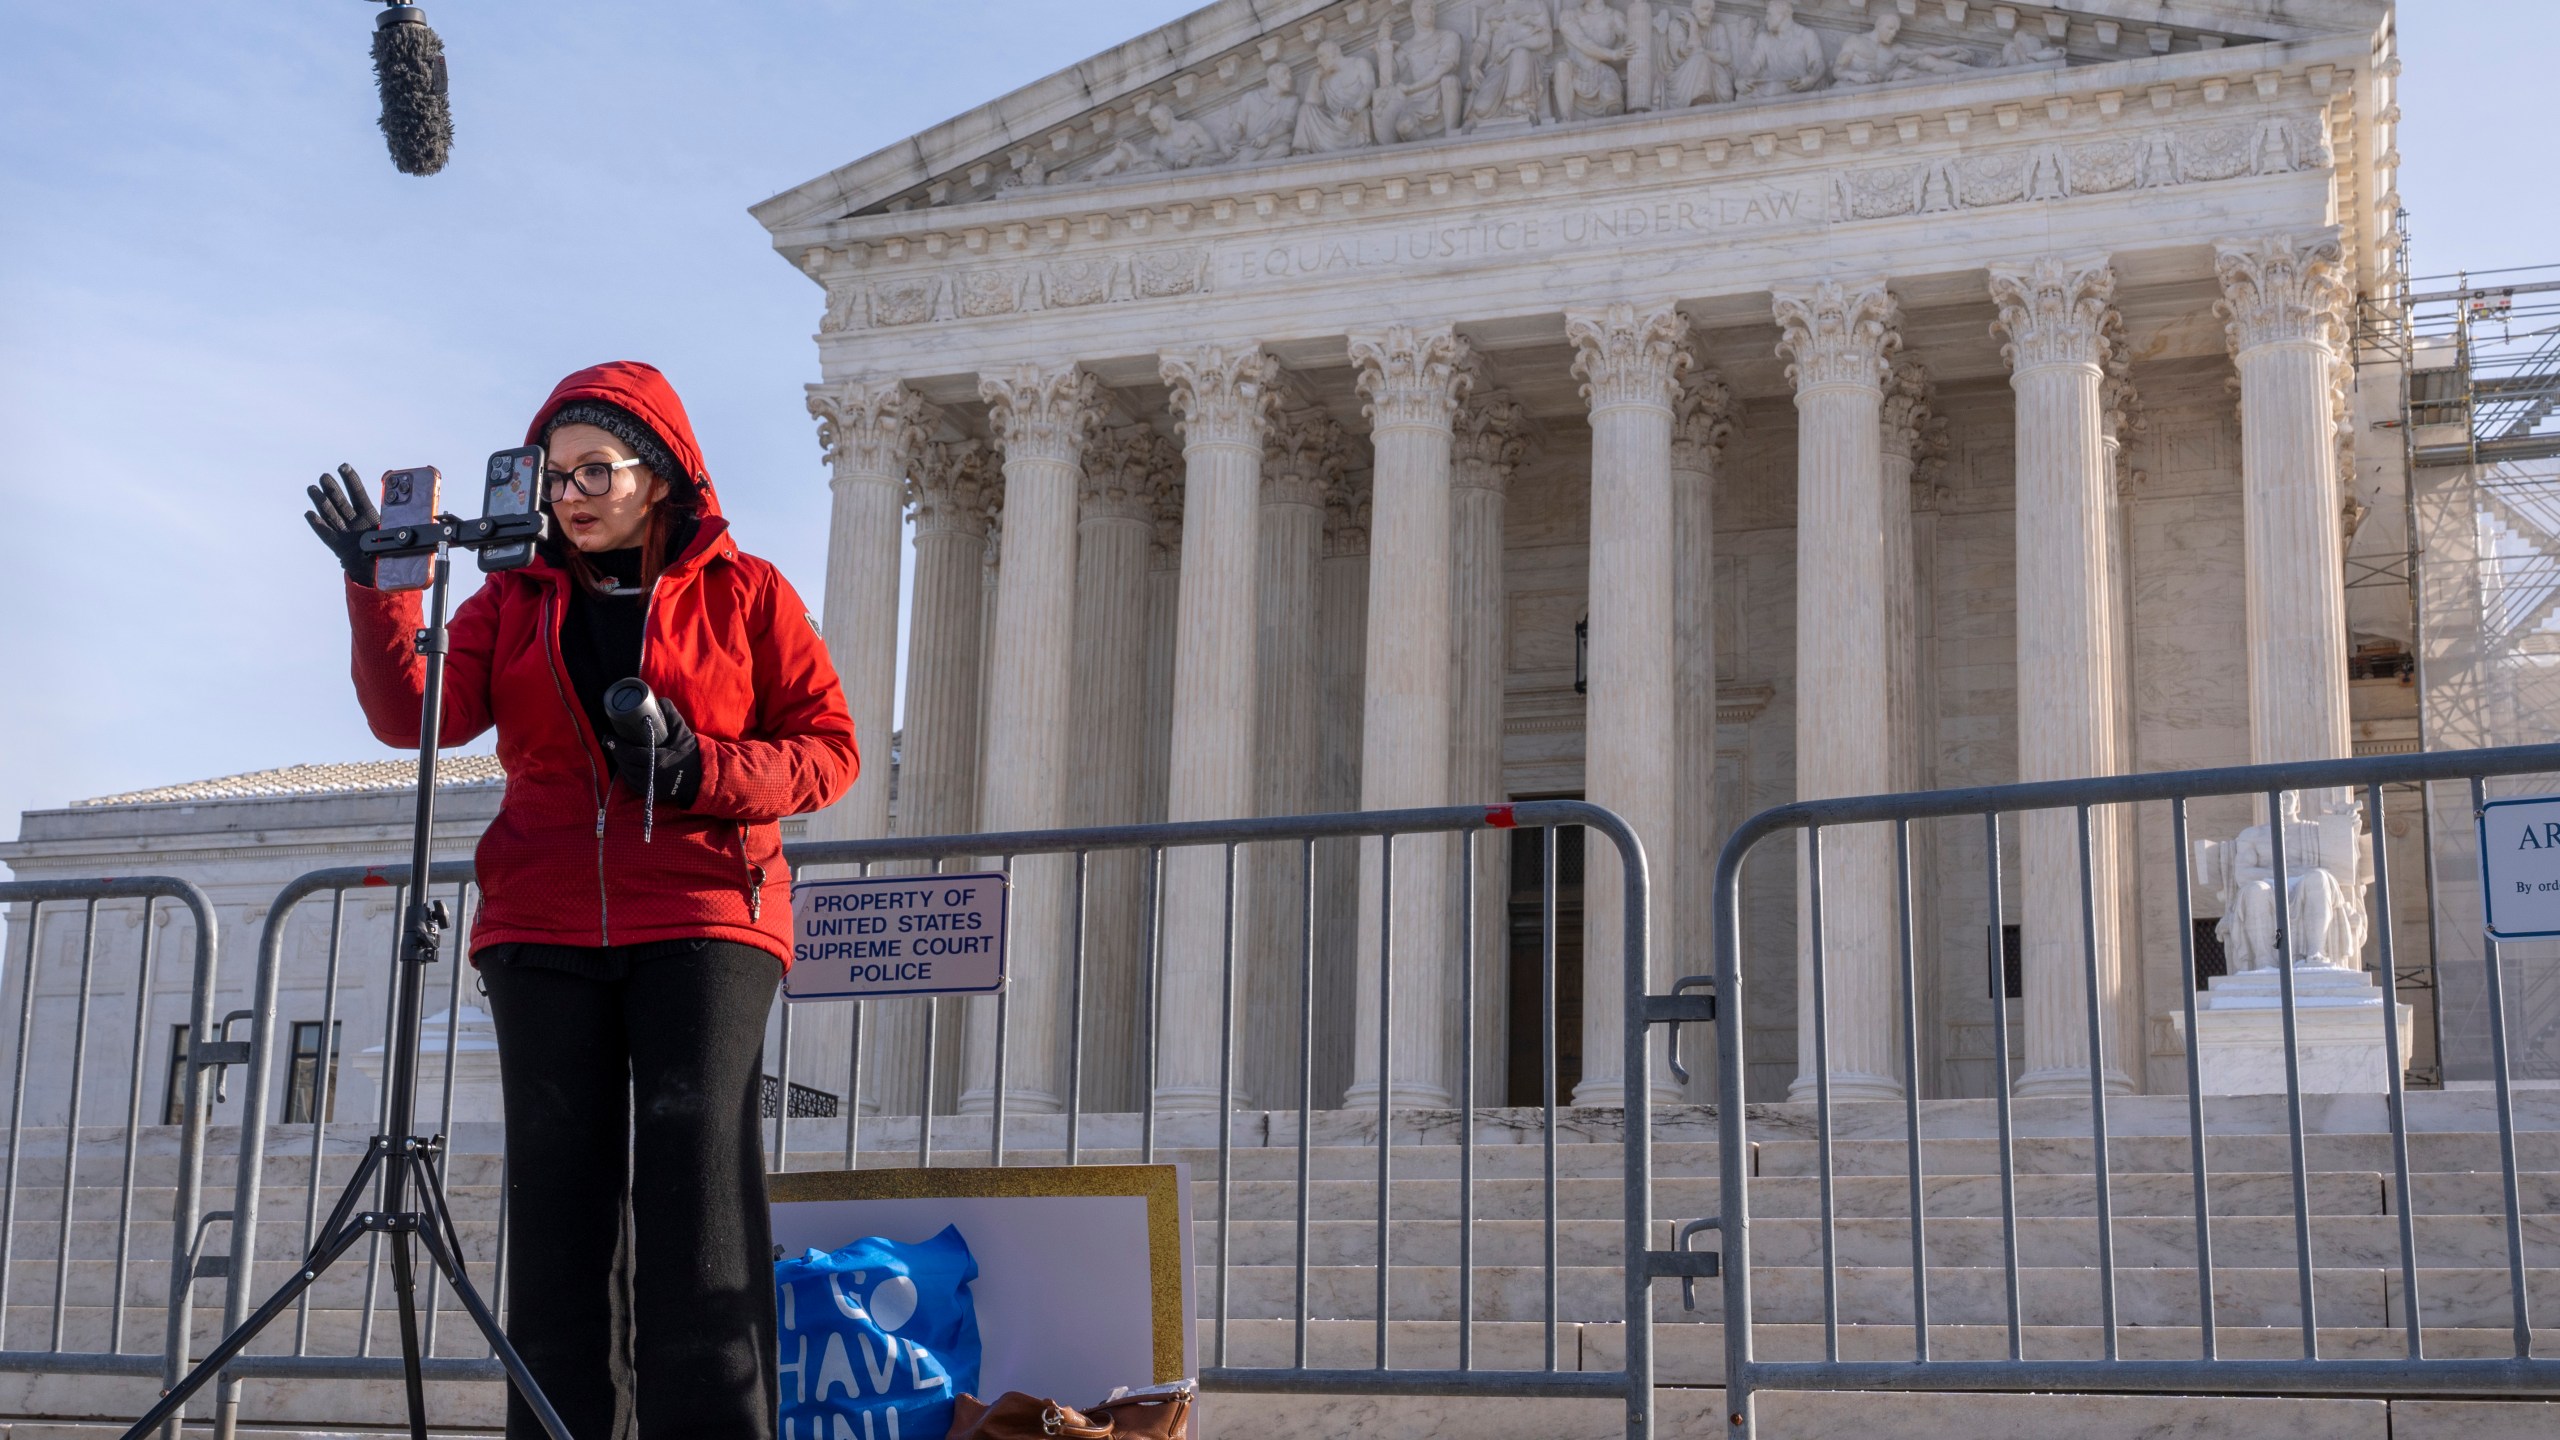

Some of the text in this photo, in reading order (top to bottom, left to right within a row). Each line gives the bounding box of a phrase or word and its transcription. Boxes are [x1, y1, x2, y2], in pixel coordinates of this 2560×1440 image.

[1241, 189, 1800, 280] EQUAL JUSTICE UNDER LAW
[671, 770, 684, 795] HEAD
[2516, 879, 2560, 894] By ord
[814, 888, 976, 913] PROPERTY OF
[806, 911, 983, 937] UNITED STATES
[794, 935, 994, 962] SUPREME COURT
[850, 962, 932, 983] POLICE
[777, 1331, 944, 1404] HAVE
